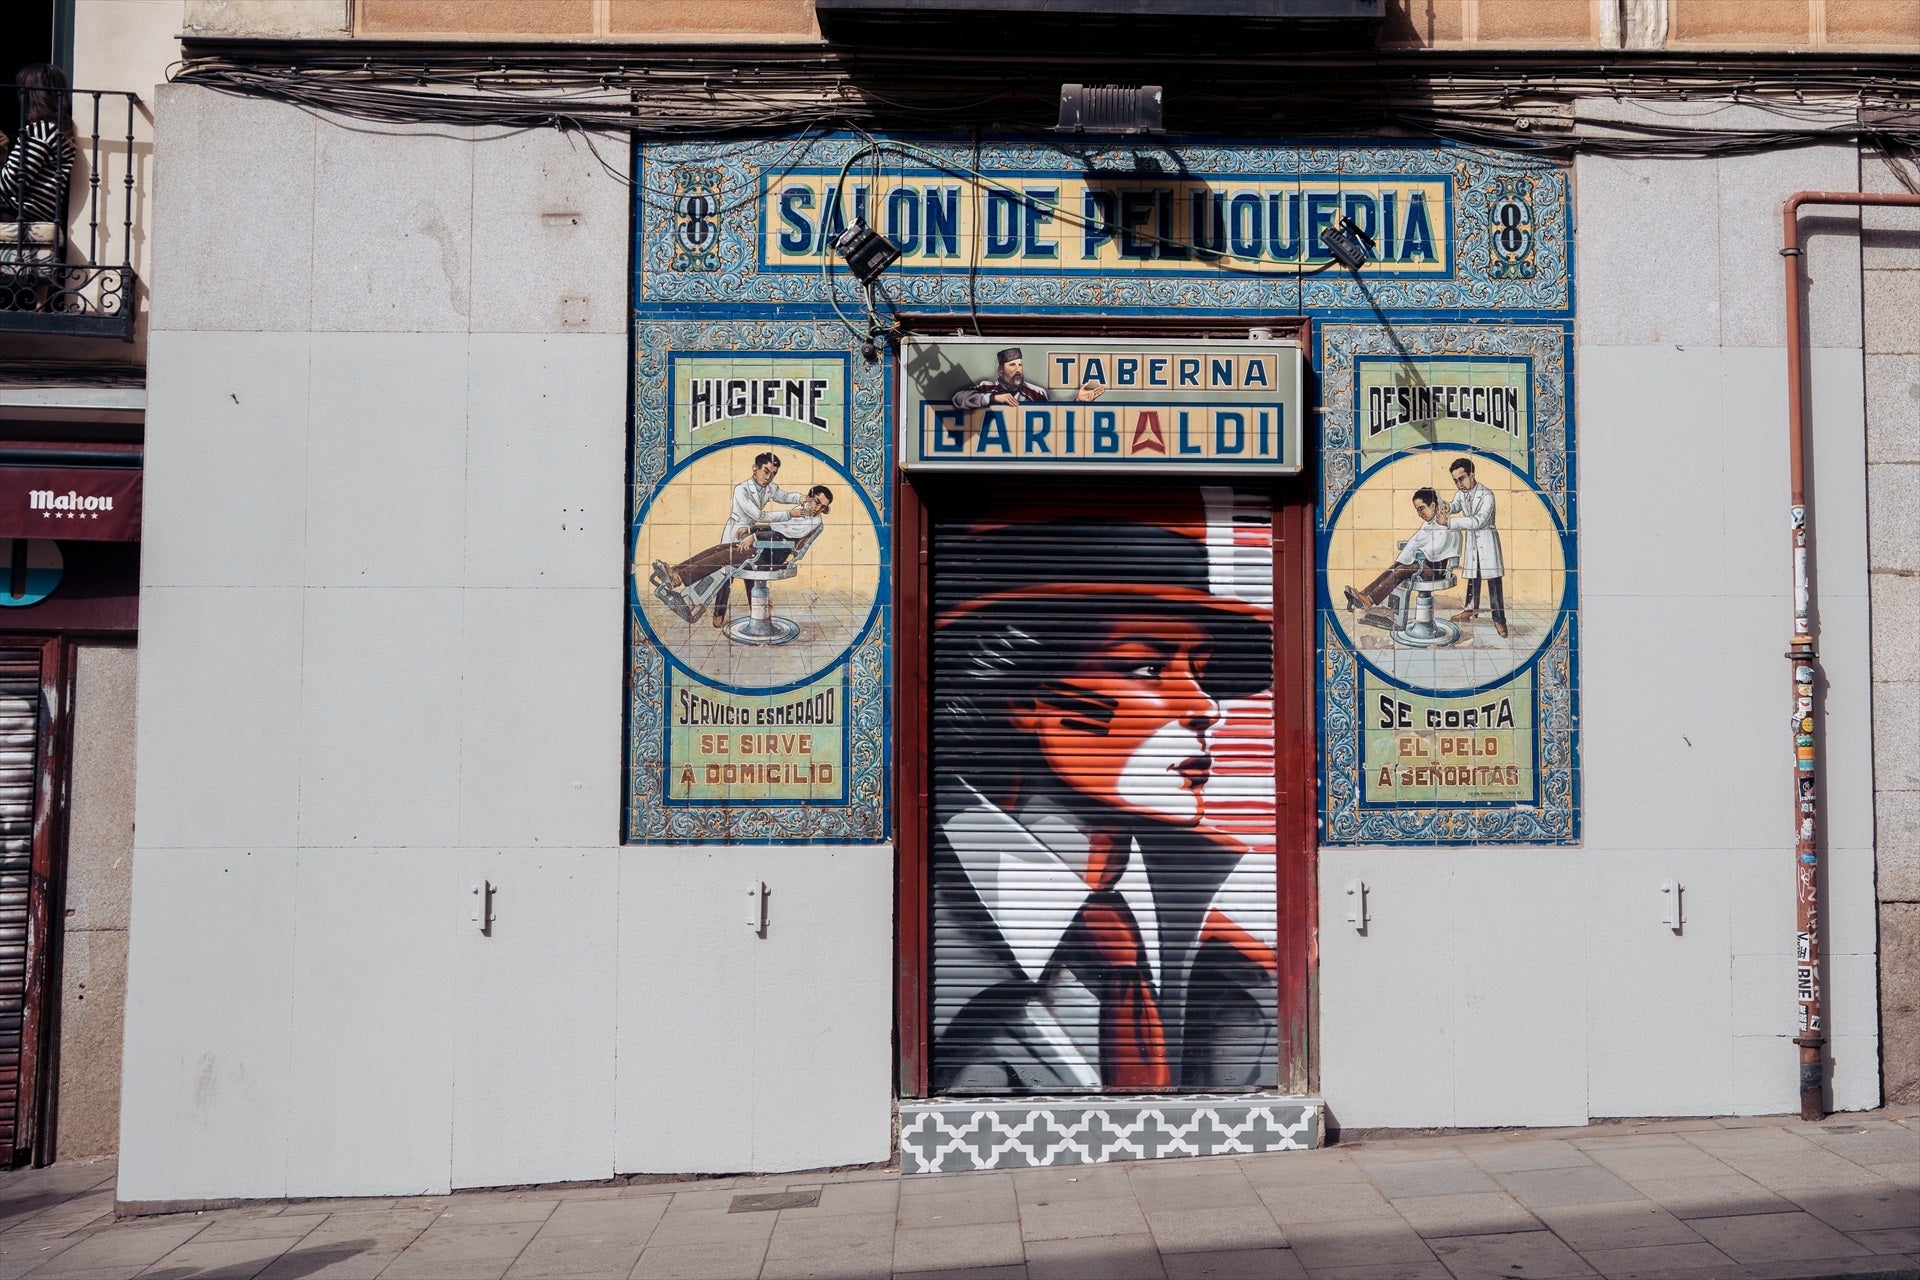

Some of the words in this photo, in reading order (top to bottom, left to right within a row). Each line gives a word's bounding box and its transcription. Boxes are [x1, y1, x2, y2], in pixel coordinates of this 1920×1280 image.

[687, 195, 709, 245] 8
[984, 186, 1059, 259] DE
[1081, 186, 1439, 263] PELUQUERIA
[1501, 202, 1521, 252] 8
[1054, 357, 1270, 387] TABERNA
[689, 378, 829, 432] HIGIENE
[1369, 386, 1519, 438] DESINFECCION
[933, 408, 1270, 456] GARIBALDI
[29, 490, 114, 510] Mahou
[679, 688, 750, 725] SERVICIO
[756, 687, 834, 725] ESMERADO
[1379, 694, 1413, 728] SE
[1425, 697, 1515, 728] CORTA
[700, 733, 729, 754] SE
[740, 733, 812, 754] SIRVE
[1399, 736, 1429, 757] EL
[1440, 736, 1498, 757] PELO
[680, 763, 697, 784] A
[705, 763, 833, 784] DOMICILIO
[1377, 766, 1393, 787] A
[1400, 761, 1519, 786] SEÑORITAS
